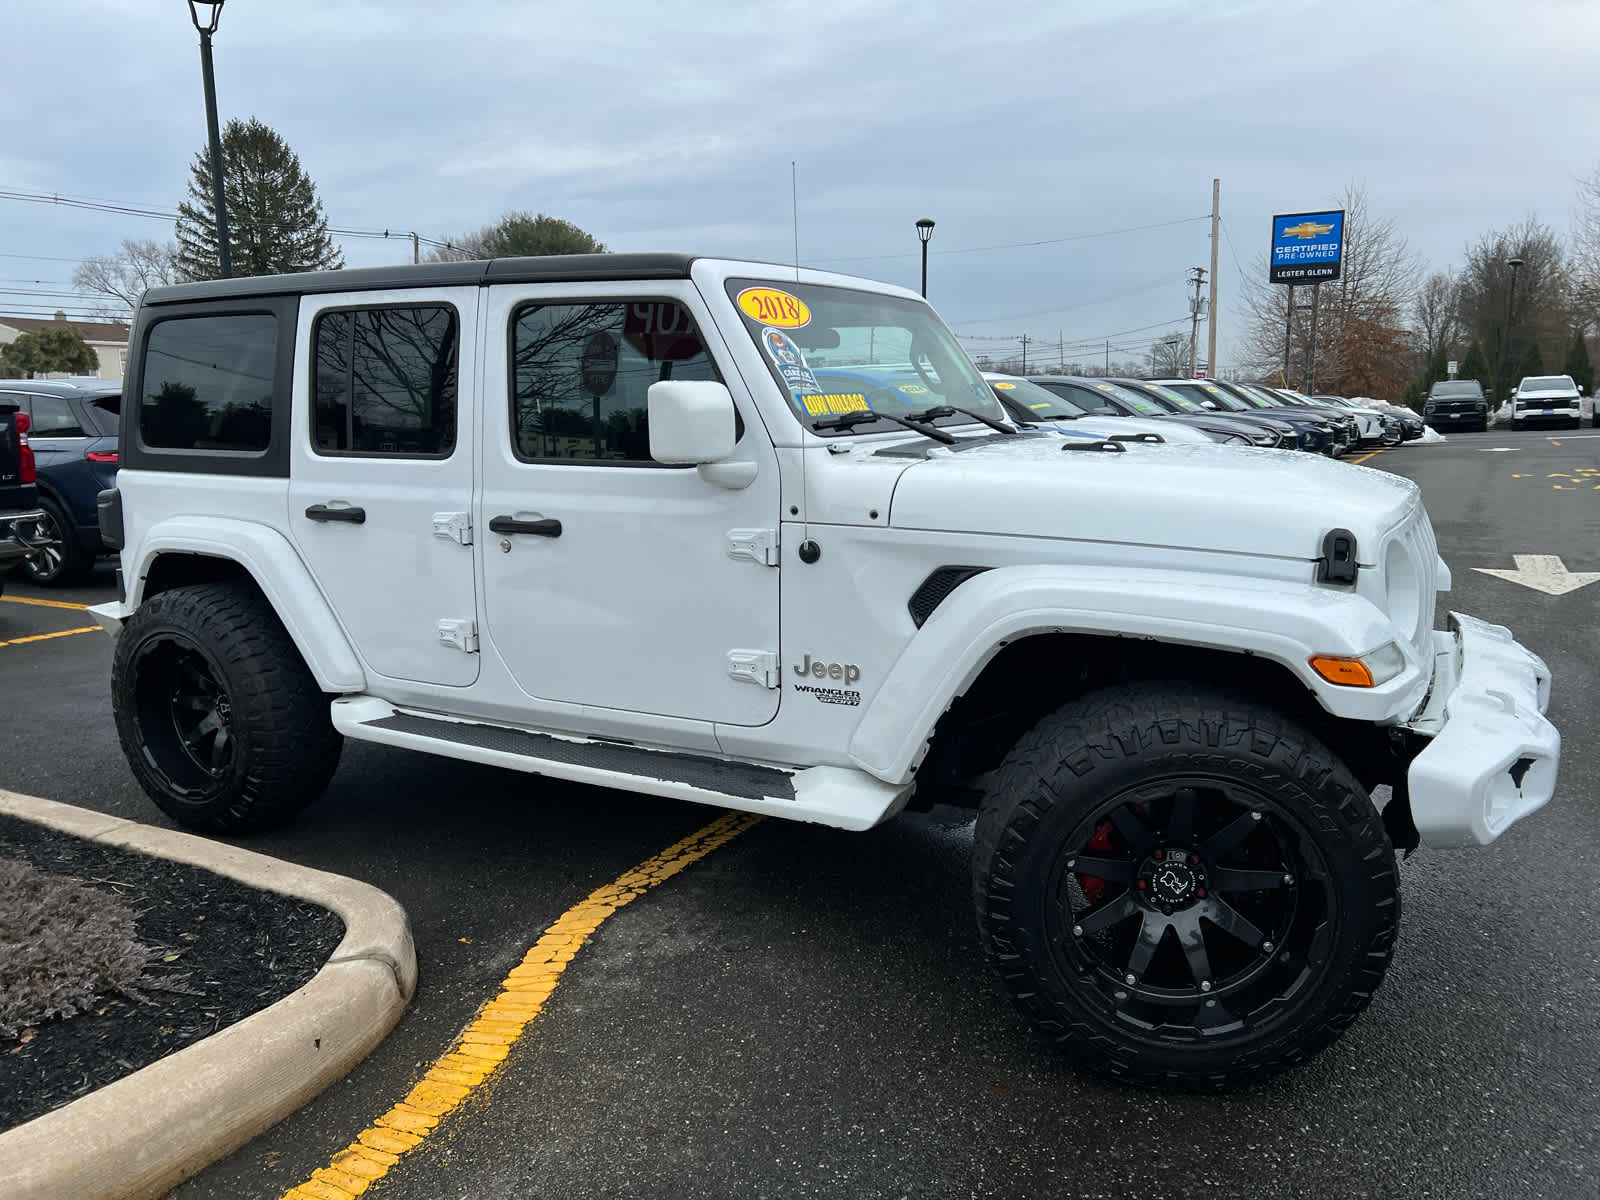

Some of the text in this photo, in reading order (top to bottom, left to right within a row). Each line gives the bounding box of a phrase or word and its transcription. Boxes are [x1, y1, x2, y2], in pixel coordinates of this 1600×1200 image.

[1276, 244, 1337, 253] CERTIFIED
[1278, 251, 1334, 259] PRE-OWNED
[751, 295, 800, 320] 2018
[802, 394, 869, 416] LOW MILEAGE
[794, 654, 860, 685] Jeep
[794, 685, 860, 696] WRANGLER
